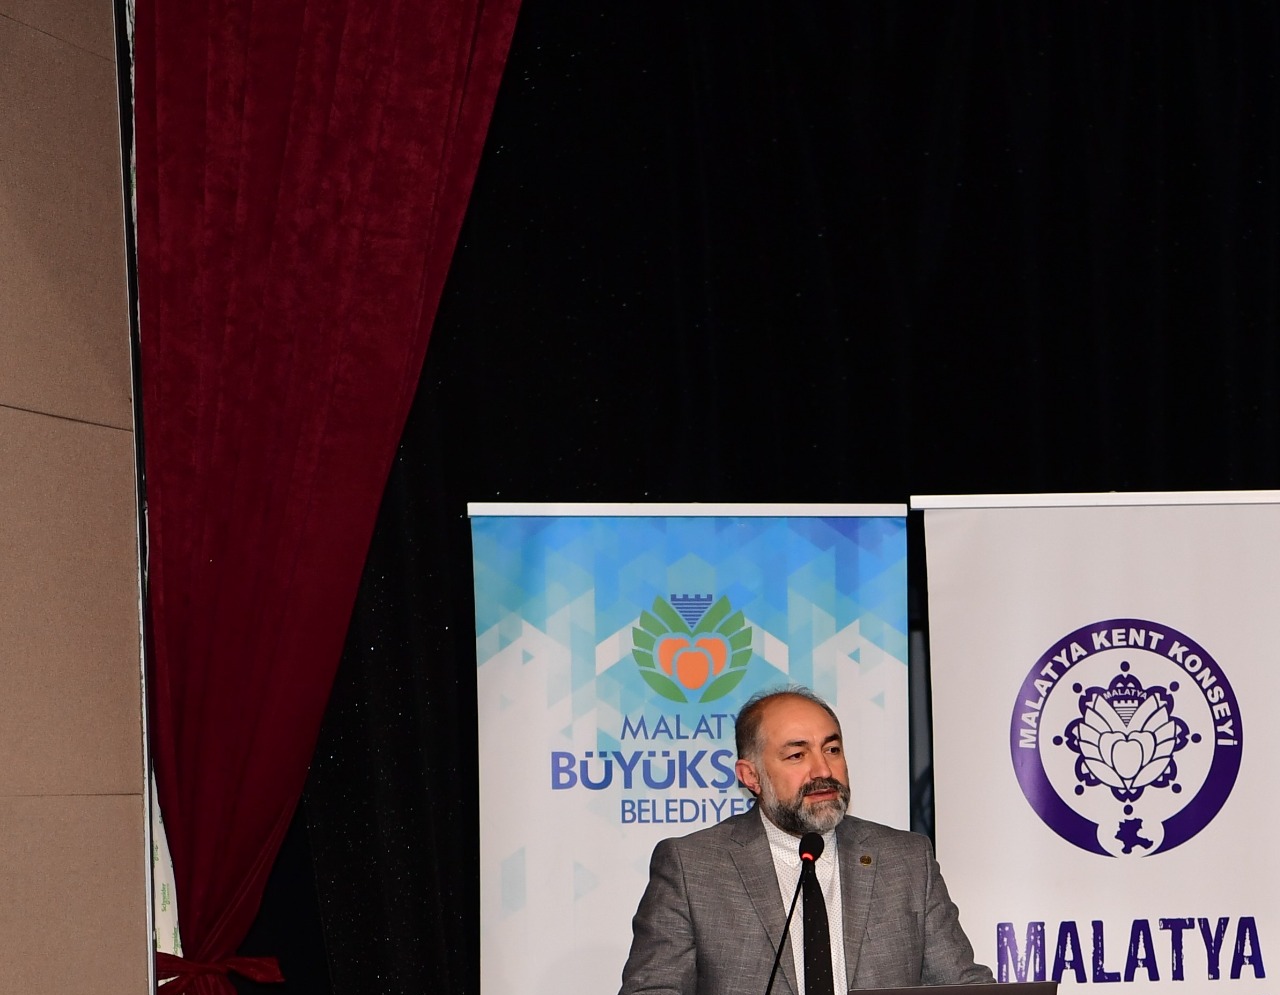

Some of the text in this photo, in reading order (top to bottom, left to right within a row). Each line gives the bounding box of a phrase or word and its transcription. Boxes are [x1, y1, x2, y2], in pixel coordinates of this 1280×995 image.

[1019, 628, 1239, 749] MALATYA KENT KONSEYİ
[1103, 688, 1148, 700] MALATYA
[620, 714, 737, 741] MALAT
[551, 749, 750, 794] BÜYÜKŞ
[620, 797, 757, 824] BELEDİYE
[996, 916, 1267, 984] MALATYA
